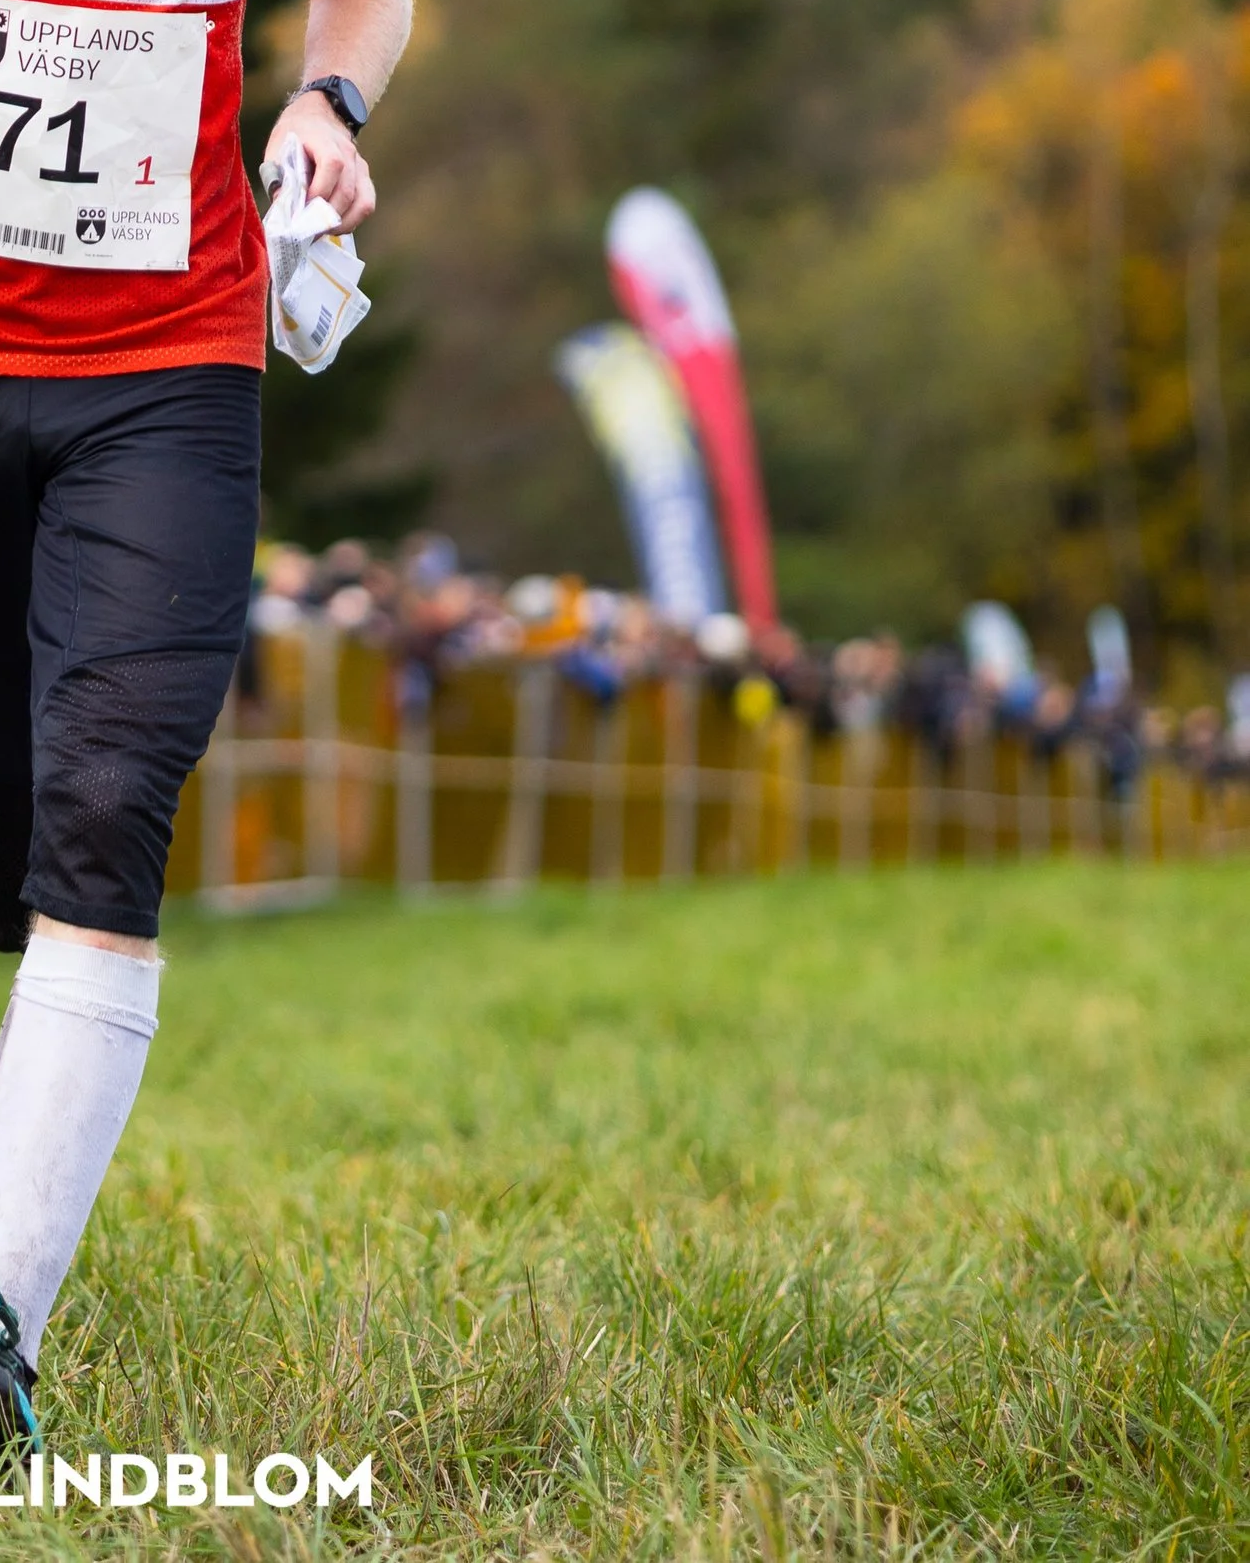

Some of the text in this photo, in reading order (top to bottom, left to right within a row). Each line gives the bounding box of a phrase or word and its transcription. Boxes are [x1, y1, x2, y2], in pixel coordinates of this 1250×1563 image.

[20, 19, 154, 53] UPPLANDS
[17, 49, 101, 80] VÄSBY
[135, 156, 155, 185] 1
[111, 211, 180, 225] UPPLANDS
[111, 226, 152, 240] VÄSBY
